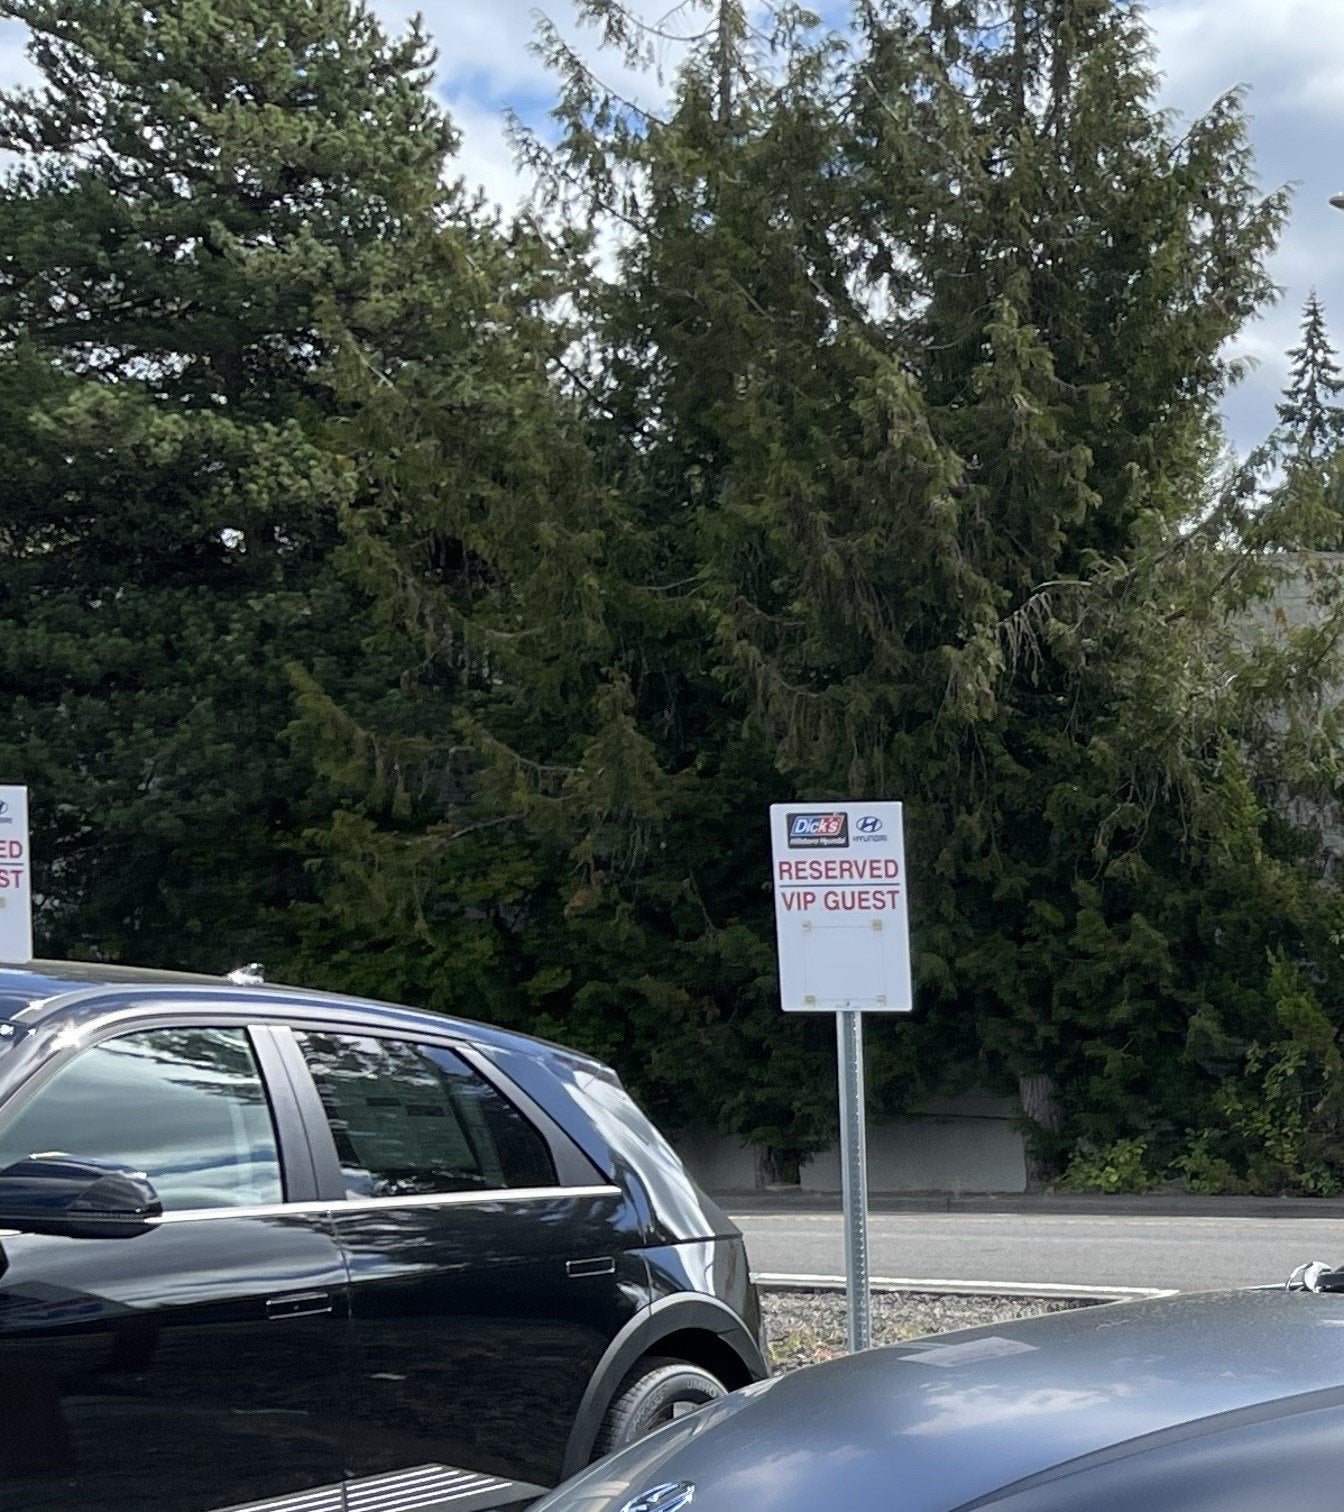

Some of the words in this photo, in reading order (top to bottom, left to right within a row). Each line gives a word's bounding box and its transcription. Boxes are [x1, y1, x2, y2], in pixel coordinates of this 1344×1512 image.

[778, 859, 899, 881] RESERVED
[781, 891, 816, 911] VIP
[824, 890, 900, 911] GUEST
